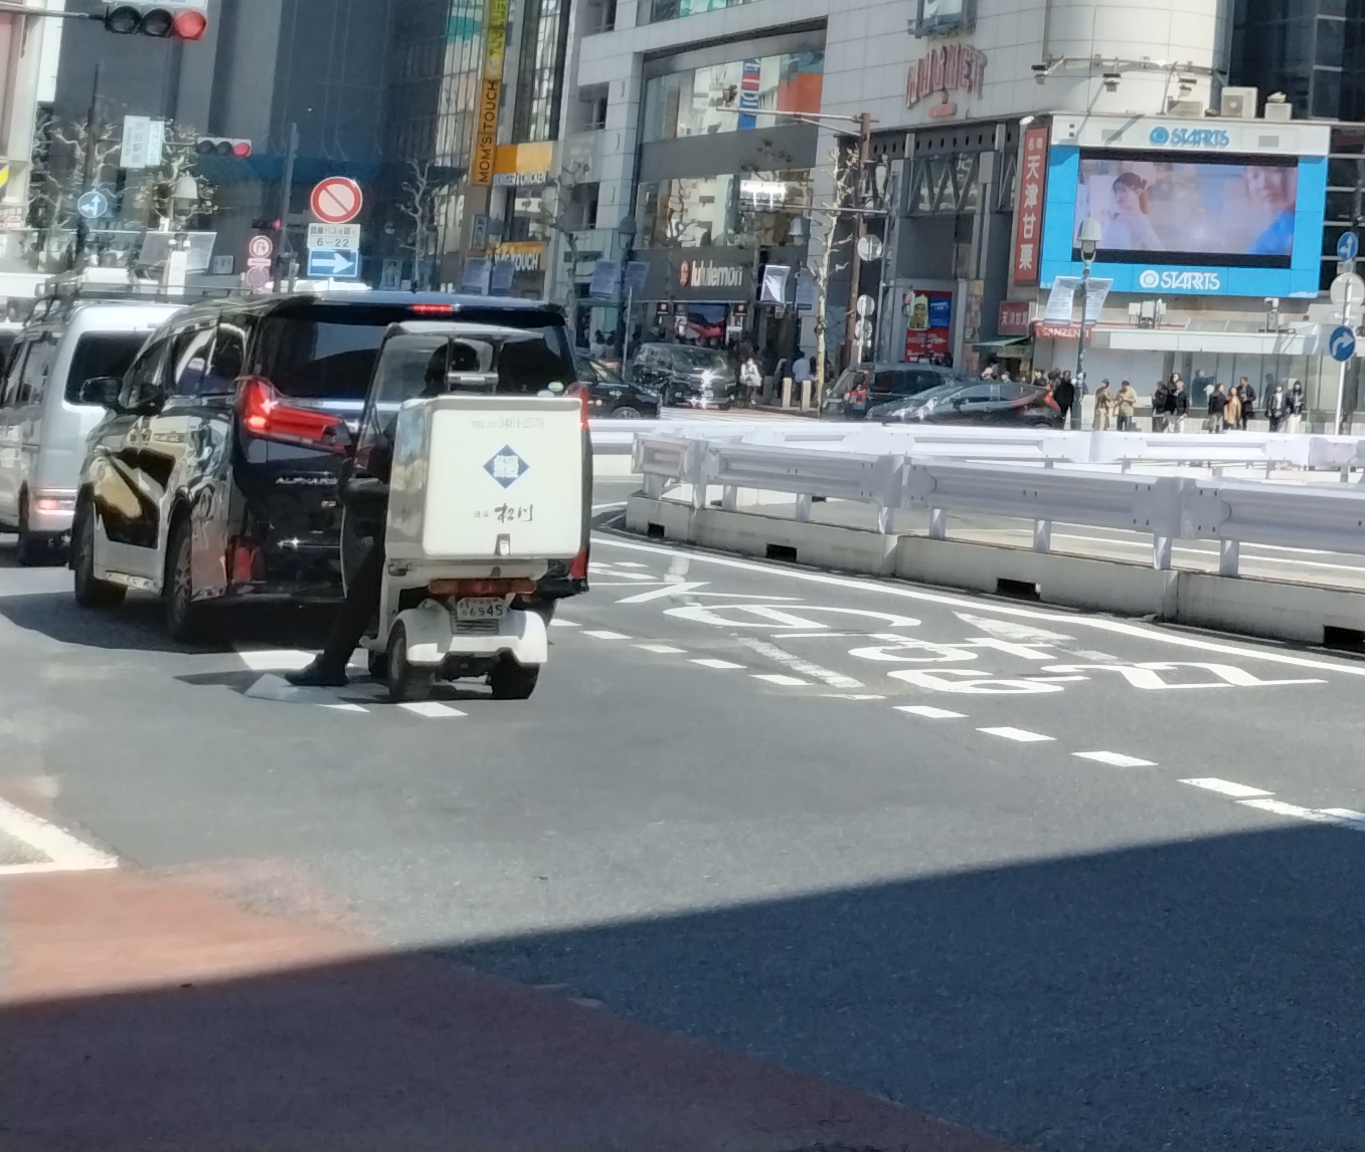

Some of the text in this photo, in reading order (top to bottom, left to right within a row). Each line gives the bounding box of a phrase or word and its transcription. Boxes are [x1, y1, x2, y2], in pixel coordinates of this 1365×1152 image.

[479, 82, 499, 183] MOM'S TOUCH
[1018, 155, 1041, 270] 天津甘栗
[691, 260, 743, 287] lululemon
[1160, 271, 1221, 290] STARTS
